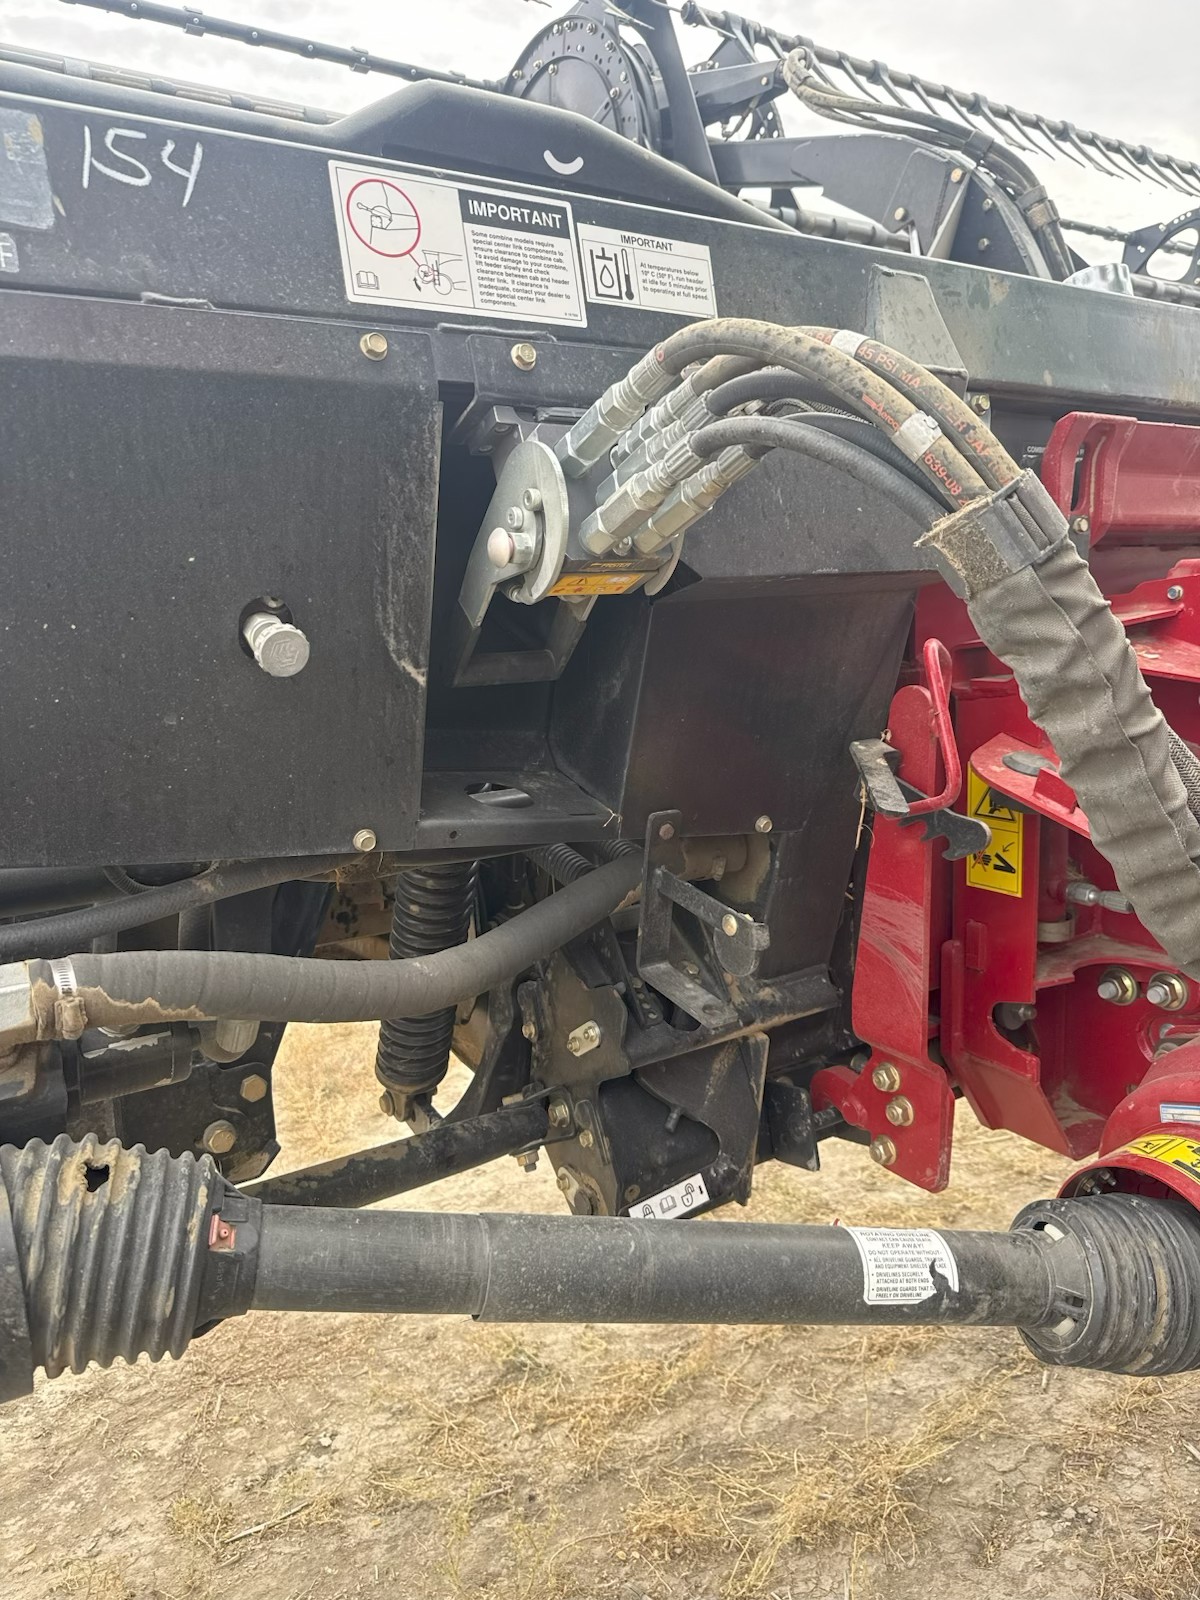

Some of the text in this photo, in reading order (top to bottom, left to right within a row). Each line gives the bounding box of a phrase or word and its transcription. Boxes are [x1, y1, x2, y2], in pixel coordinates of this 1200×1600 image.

[82, 125, 203, 207] 154
[468, 199, 562, 229] IMPORTANT
[471, 230, 554, 248] Some combine models require
[621, 234, 673, 251] IMPORTANT
[473, 238, 492, 246] special
[524, 246, 557, 255] components
[495, 248, 520, 257] clearance
[529, 253, 552, 261] combine
[500, 256, 522, 265] damage
[544, 263, 568, 271] combine,
[504, 264, 521, 272] slowly
[648, 263, 682, 274] temperatures
[477, 268, 504, 276] clearance
[505, 271, 528, 279] between
[516, 280, 542, 289] clearance
[496, 292, 516, 300] special
[650, 287, 675, 297] operating
[480, 298, 517, 307] components.
[874, 353, 900, 373] PSI
[923, 451, 963, 496] 639-08
